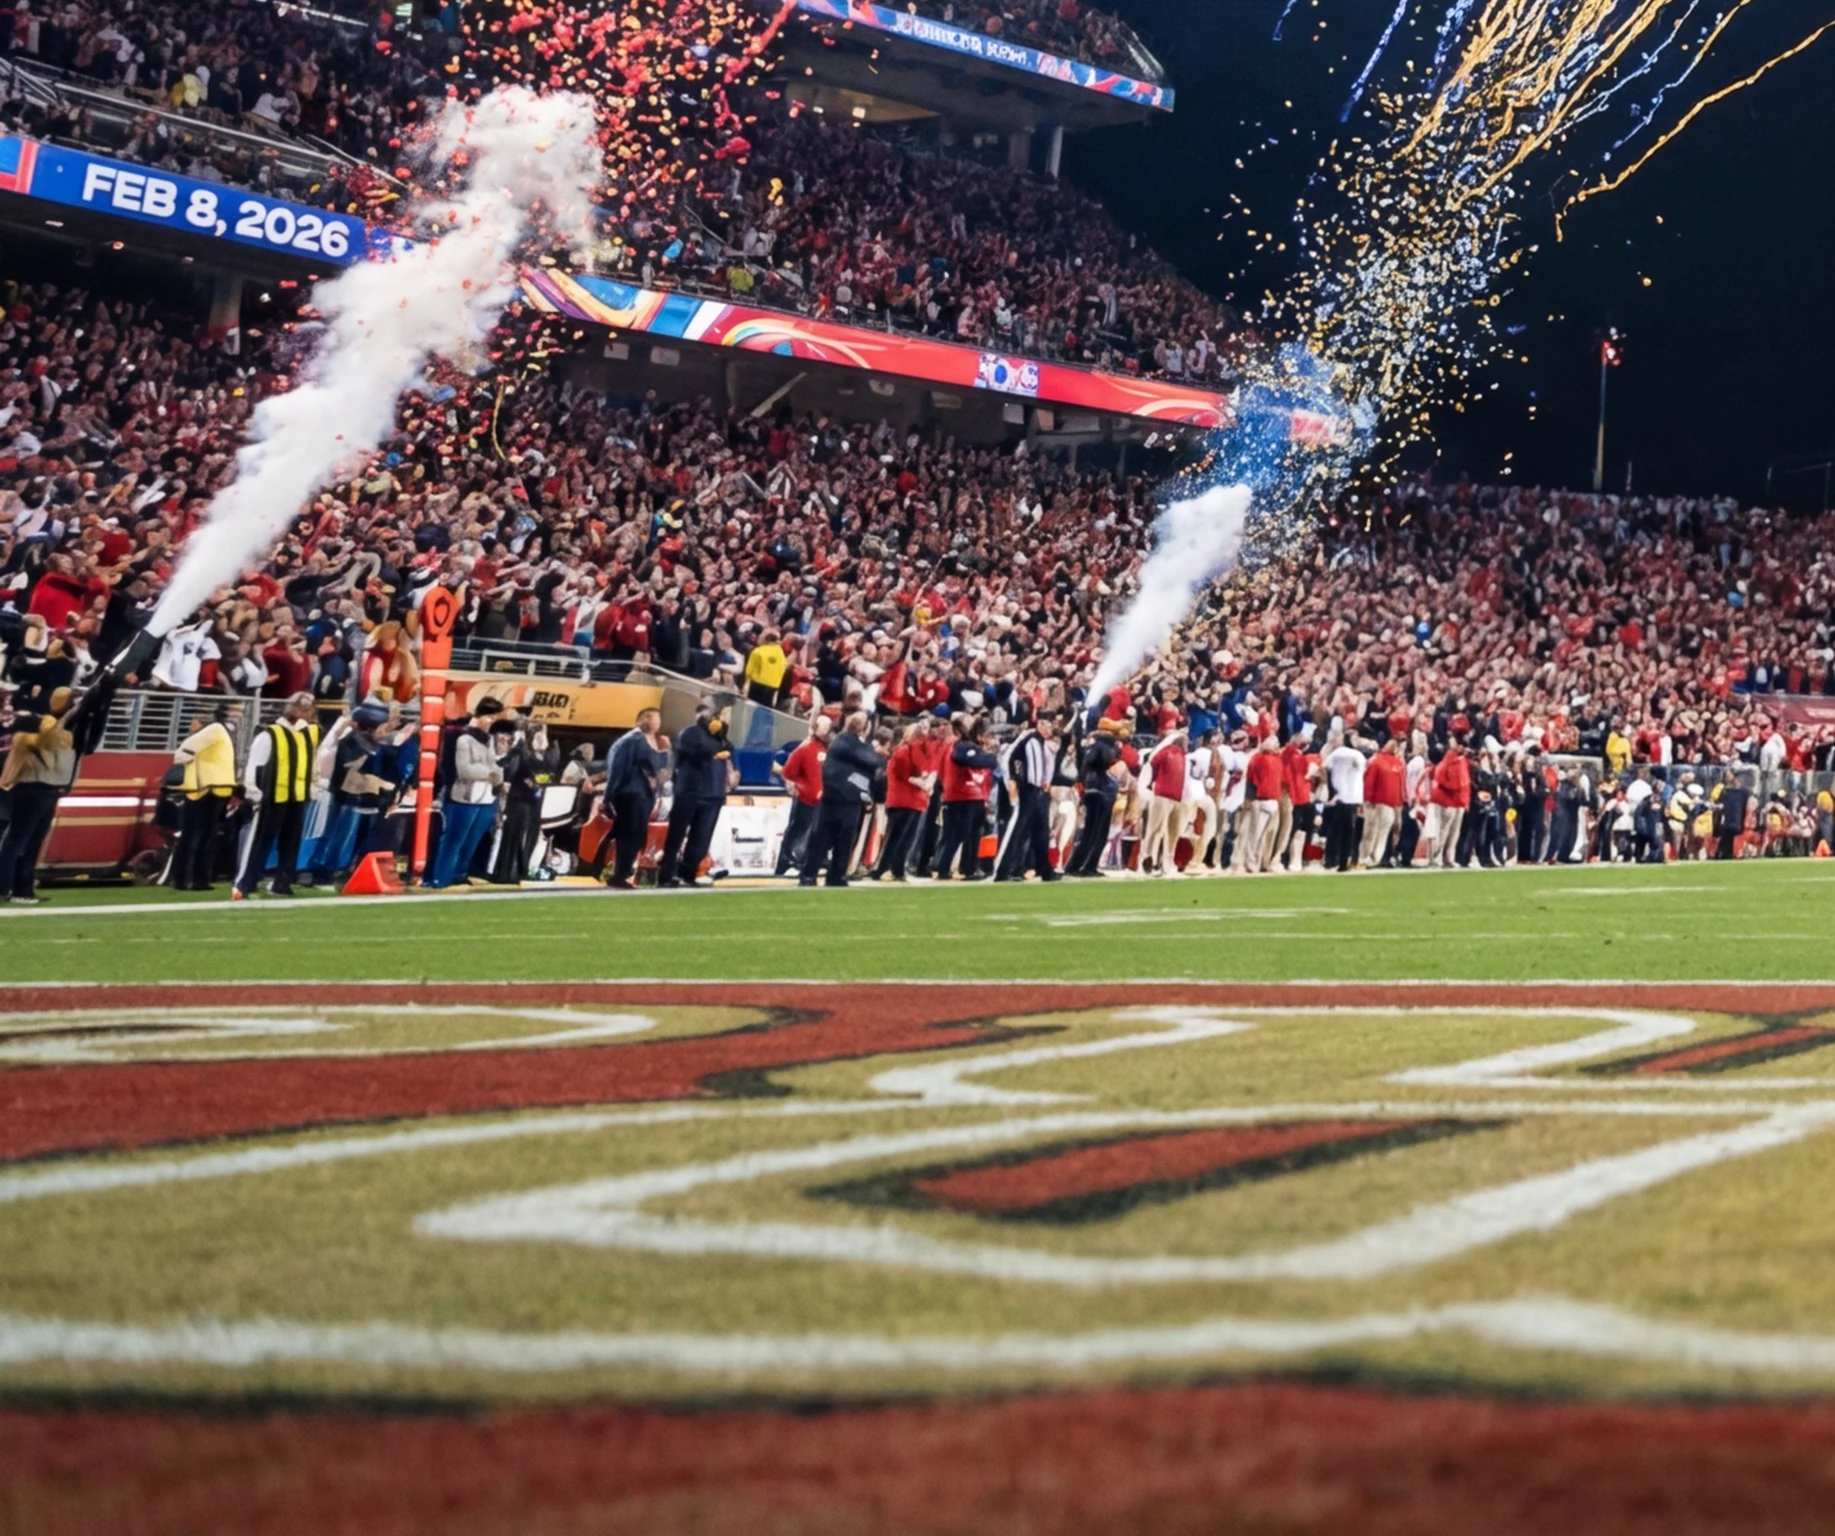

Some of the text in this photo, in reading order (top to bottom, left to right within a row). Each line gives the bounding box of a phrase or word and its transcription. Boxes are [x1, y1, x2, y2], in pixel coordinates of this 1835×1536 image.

[82, 163, 350, 258] FEB 8, 2026
